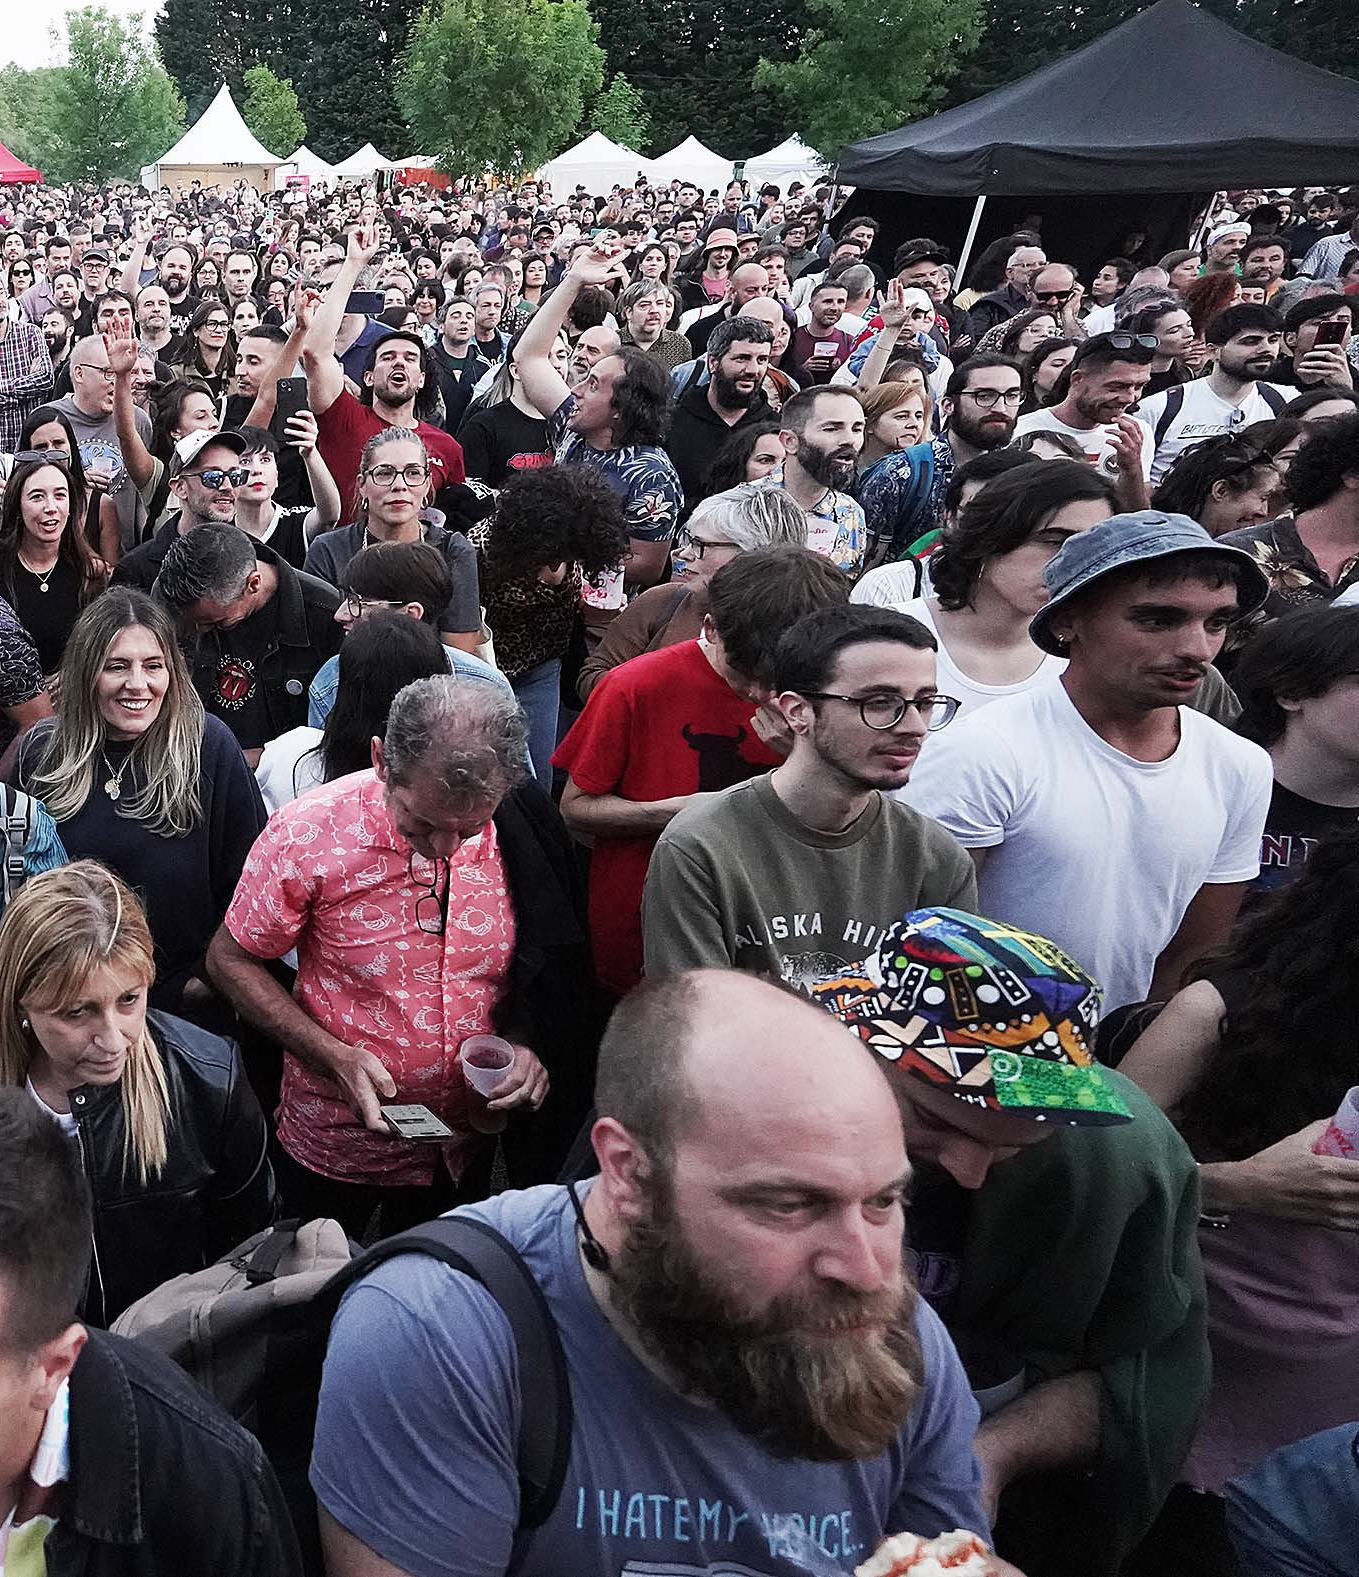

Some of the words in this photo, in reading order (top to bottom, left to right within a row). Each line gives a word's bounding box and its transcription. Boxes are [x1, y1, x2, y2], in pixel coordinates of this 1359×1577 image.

[575, 1486, 586, 1530] I
[597, 1488, 691, 1542] HATE
[699, 1497, 749, 1543] MY
